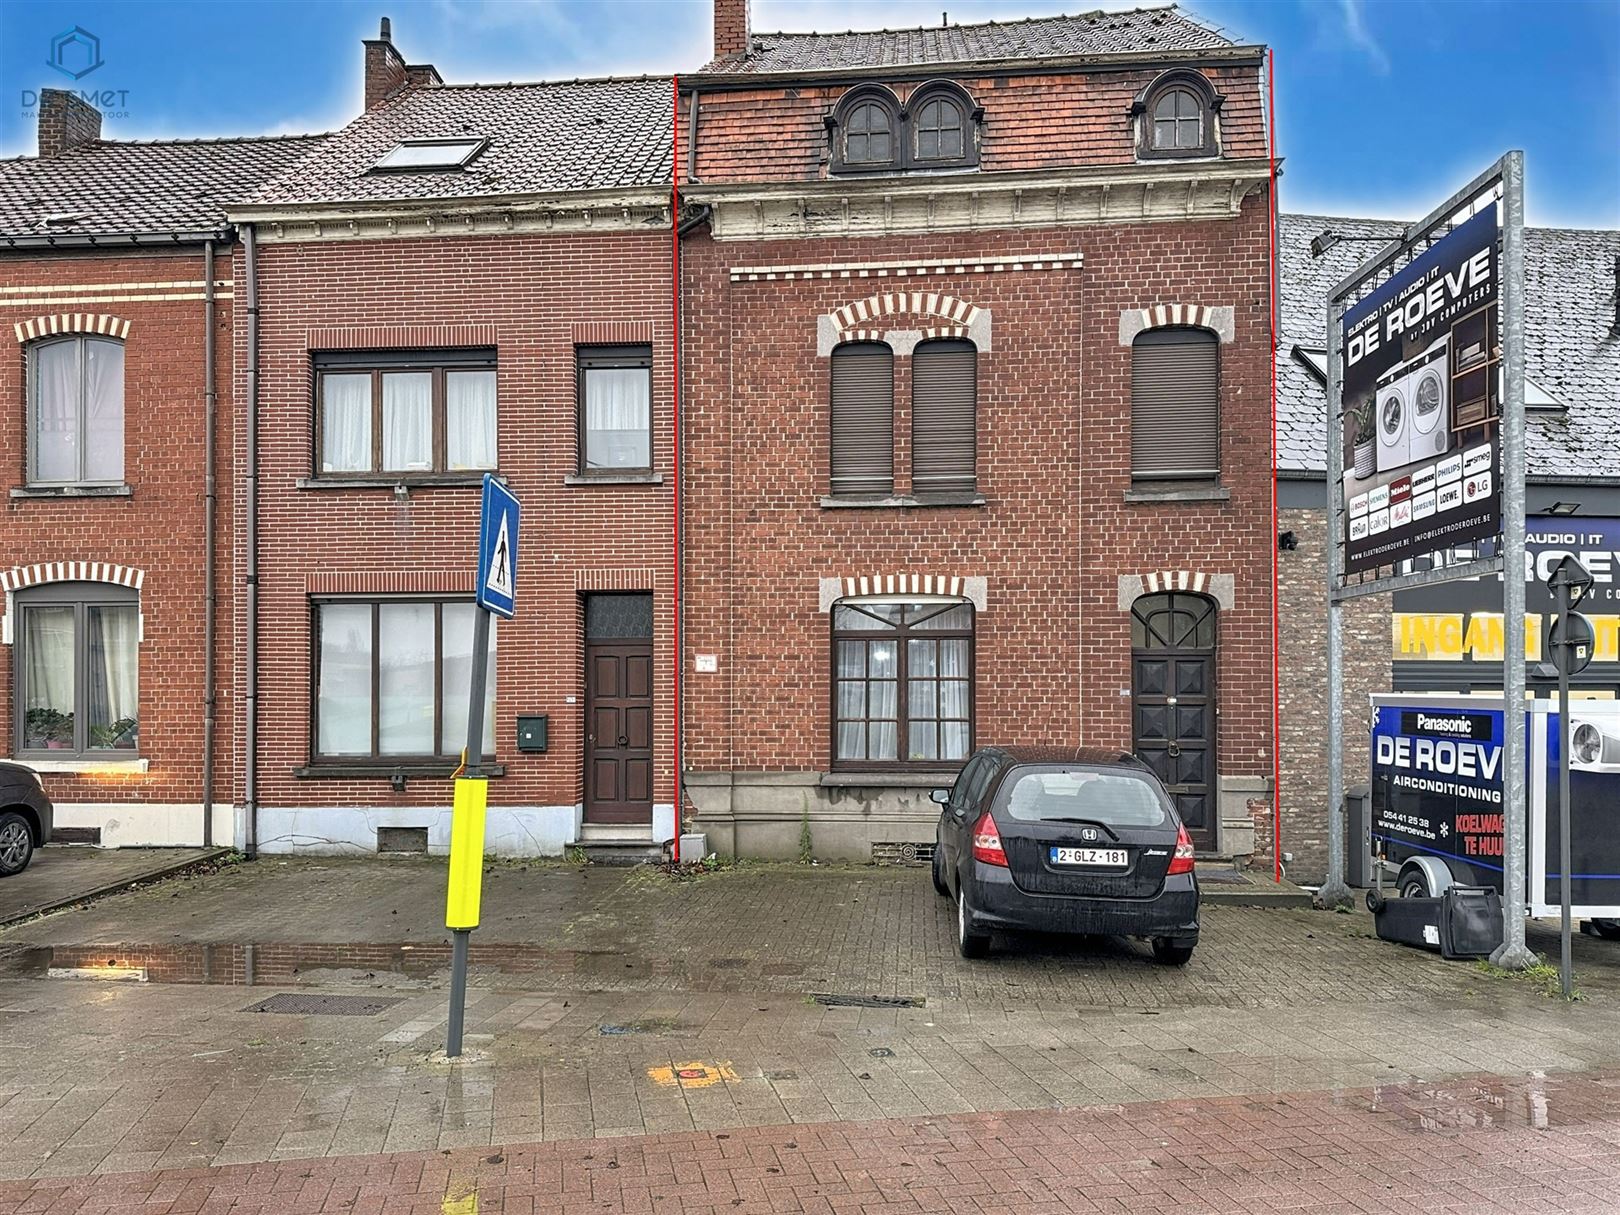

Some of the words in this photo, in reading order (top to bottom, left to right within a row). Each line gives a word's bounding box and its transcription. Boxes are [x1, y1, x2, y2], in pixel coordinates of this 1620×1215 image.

[1347, 311, 1378, 338] ELEKTRO
[1383, 299, 1394, 312] TV
[1399, 276, 1425, 302] AUDIO
[1431, 265, 1440, 279] IT
[1347, 322, 1380, 367] DE
[1386, 246, 1491, 342] ROEVE
[1440, 283, 1491, 321] COMPUTERS
[1473, 451, 1491, 464] smeg
[1437, 462, 1461, 478] PHILIPS
[1477, 479, 1489, 493] LG
[1413, 498, 1435, 512] SAMSUNG
[1525, 533, 1576, 544] AUDIO
[1588, 534, 1604, 545] IT
[1417, 713, 1473, 734] Panasonic
[1377, 735, 1411, 768] DE
[1415, 738, 1504, 782] ROEV
[1393, 774, 1501, 803] AIRCONDITIONING
[1383, 810, 1397, 820] 054
[1398, 814, 1407, 823] 41
[1408, 815, 1418, 825] 25
[1378, 819, 1436, 840] www.deroeve.be
[1464, 836, 1477, 856] TE
[1479, 836, 1504, 856] HUU
